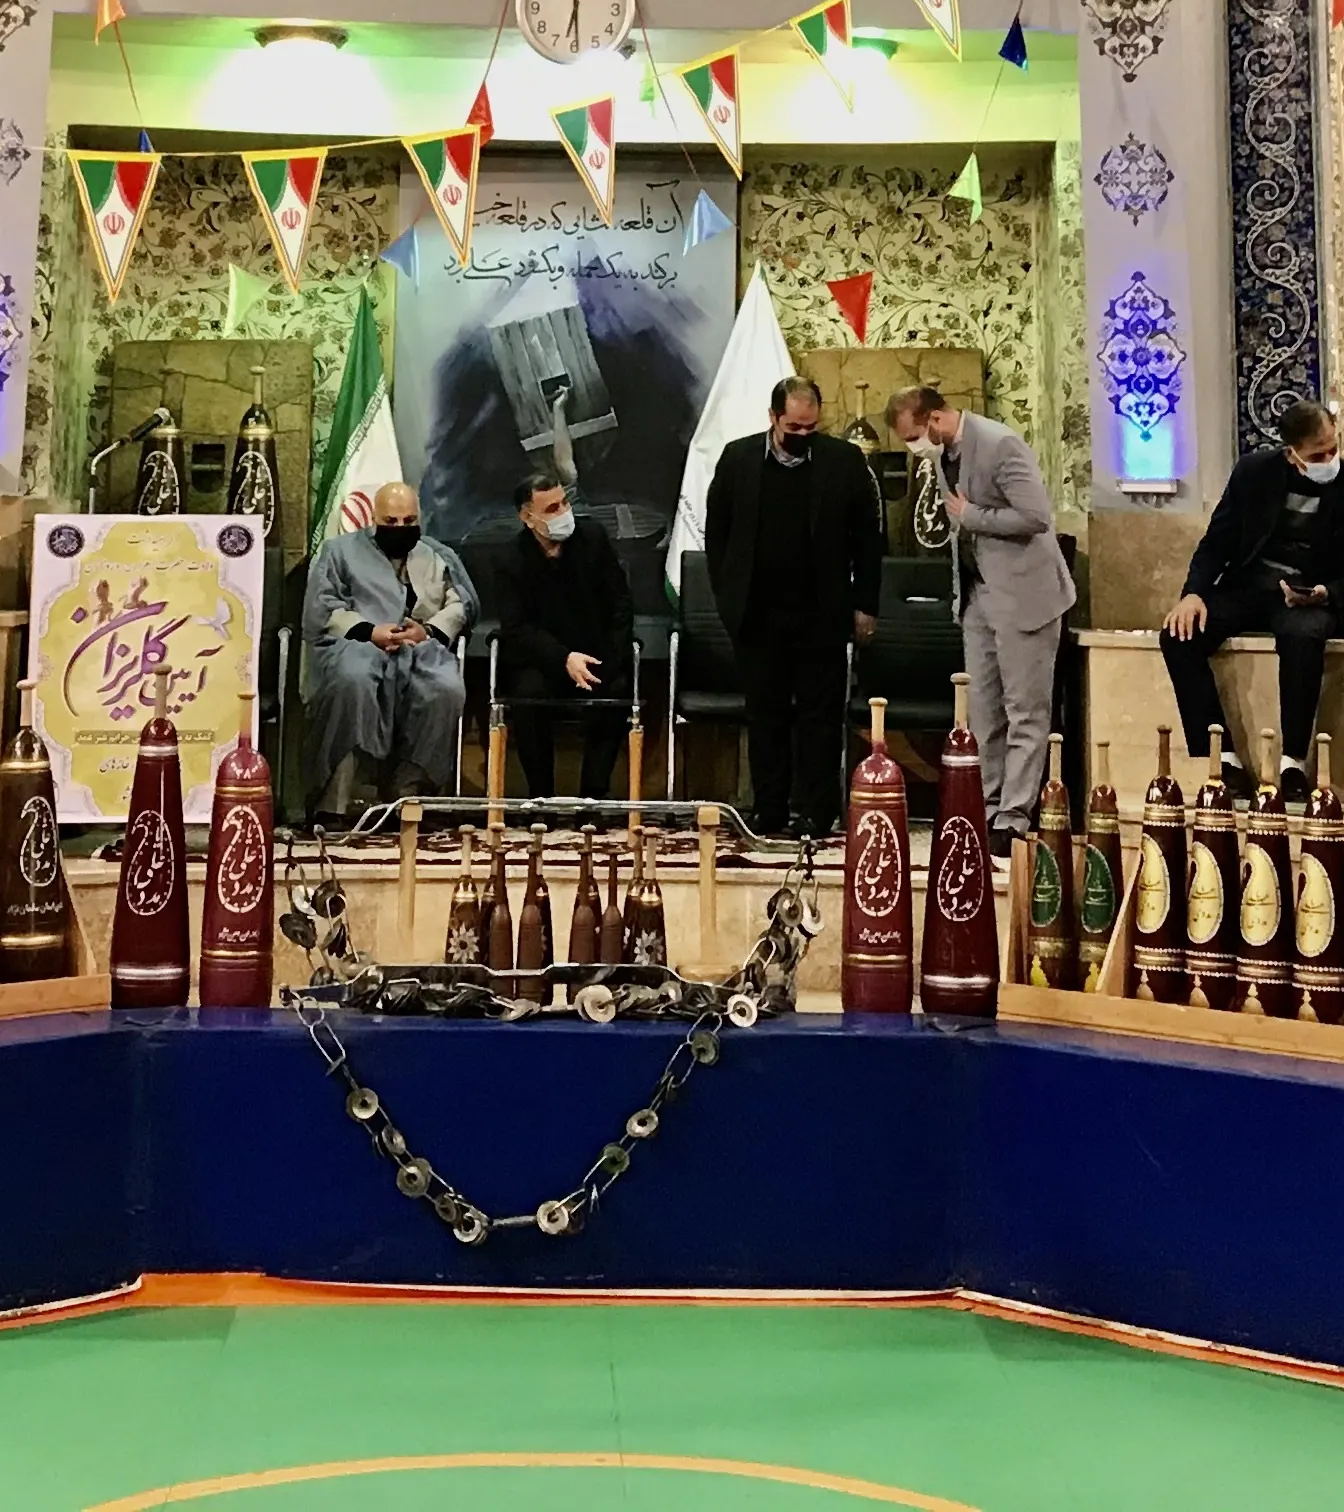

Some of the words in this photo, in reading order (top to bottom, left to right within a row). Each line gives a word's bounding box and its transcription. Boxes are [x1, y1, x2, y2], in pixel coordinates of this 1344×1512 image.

[530, 1, 540, 15] 9
[610, 3, 621, 17] 3
[537, 20, 546, 34] 8
[604, 22, 614, 36] 4
[551, 34, 561, 47] 7
[569, 39, 580, 54] 6
[590, 35, 600, 49] 5
